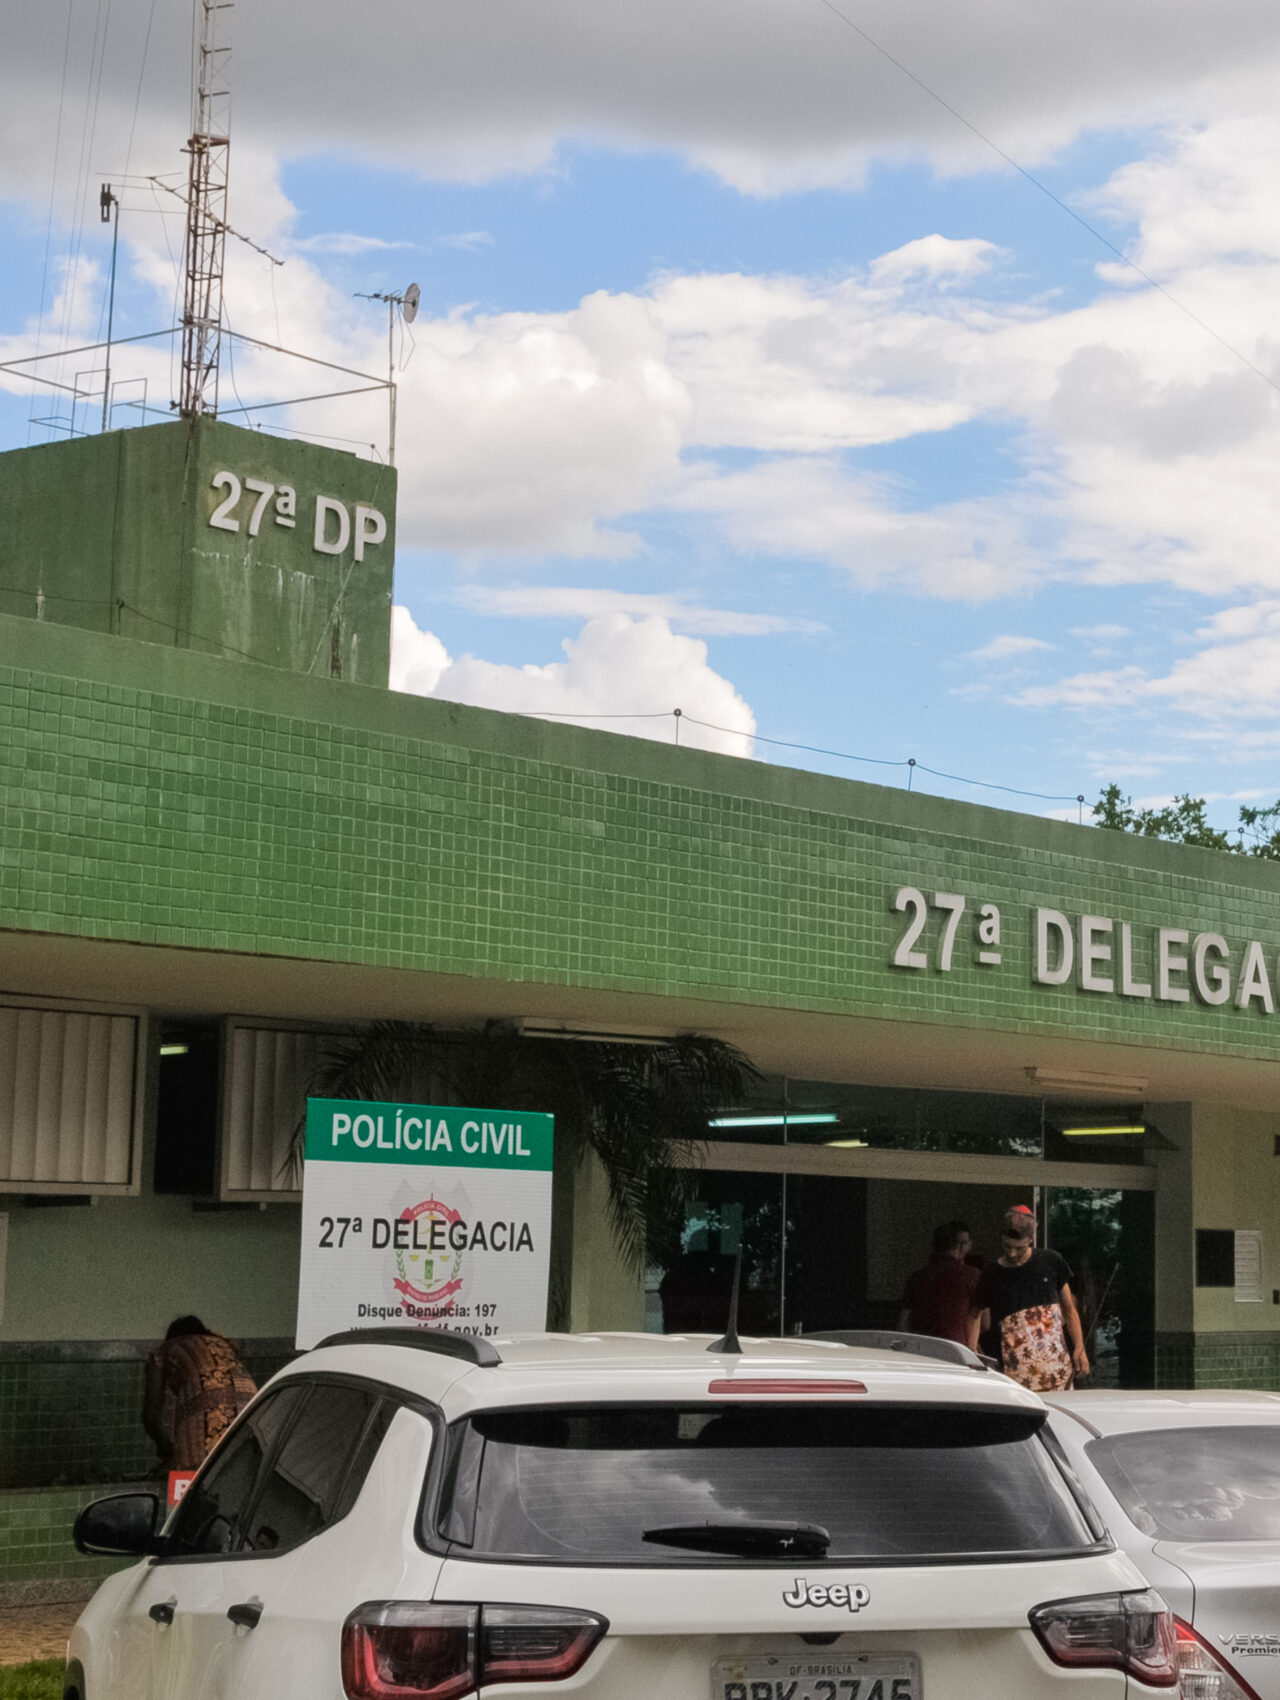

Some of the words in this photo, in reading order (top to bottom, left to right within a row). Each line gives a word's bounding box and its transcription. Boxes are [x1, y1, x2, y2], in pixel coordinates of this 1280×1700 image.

[208, 471, 296, 536] 27ª
[314, 495, 387, 561] DP
[893, 886, 1001, 972] 27ª
[332, 1109, 452, 1151] POLÍCIA
[460, 1121, 532, 1156] CIVIL
[319, 1217, 363, 1248] 27ª
[372, 1218, 535, 1252] DELEGACIA
[358, 1304, 402, 1320] Disque
[407, 1304, 470, 1318] Denúncia:
[475, 1304, 497, 1317] 197
[782, 1578, 871, 1612] Jeep
